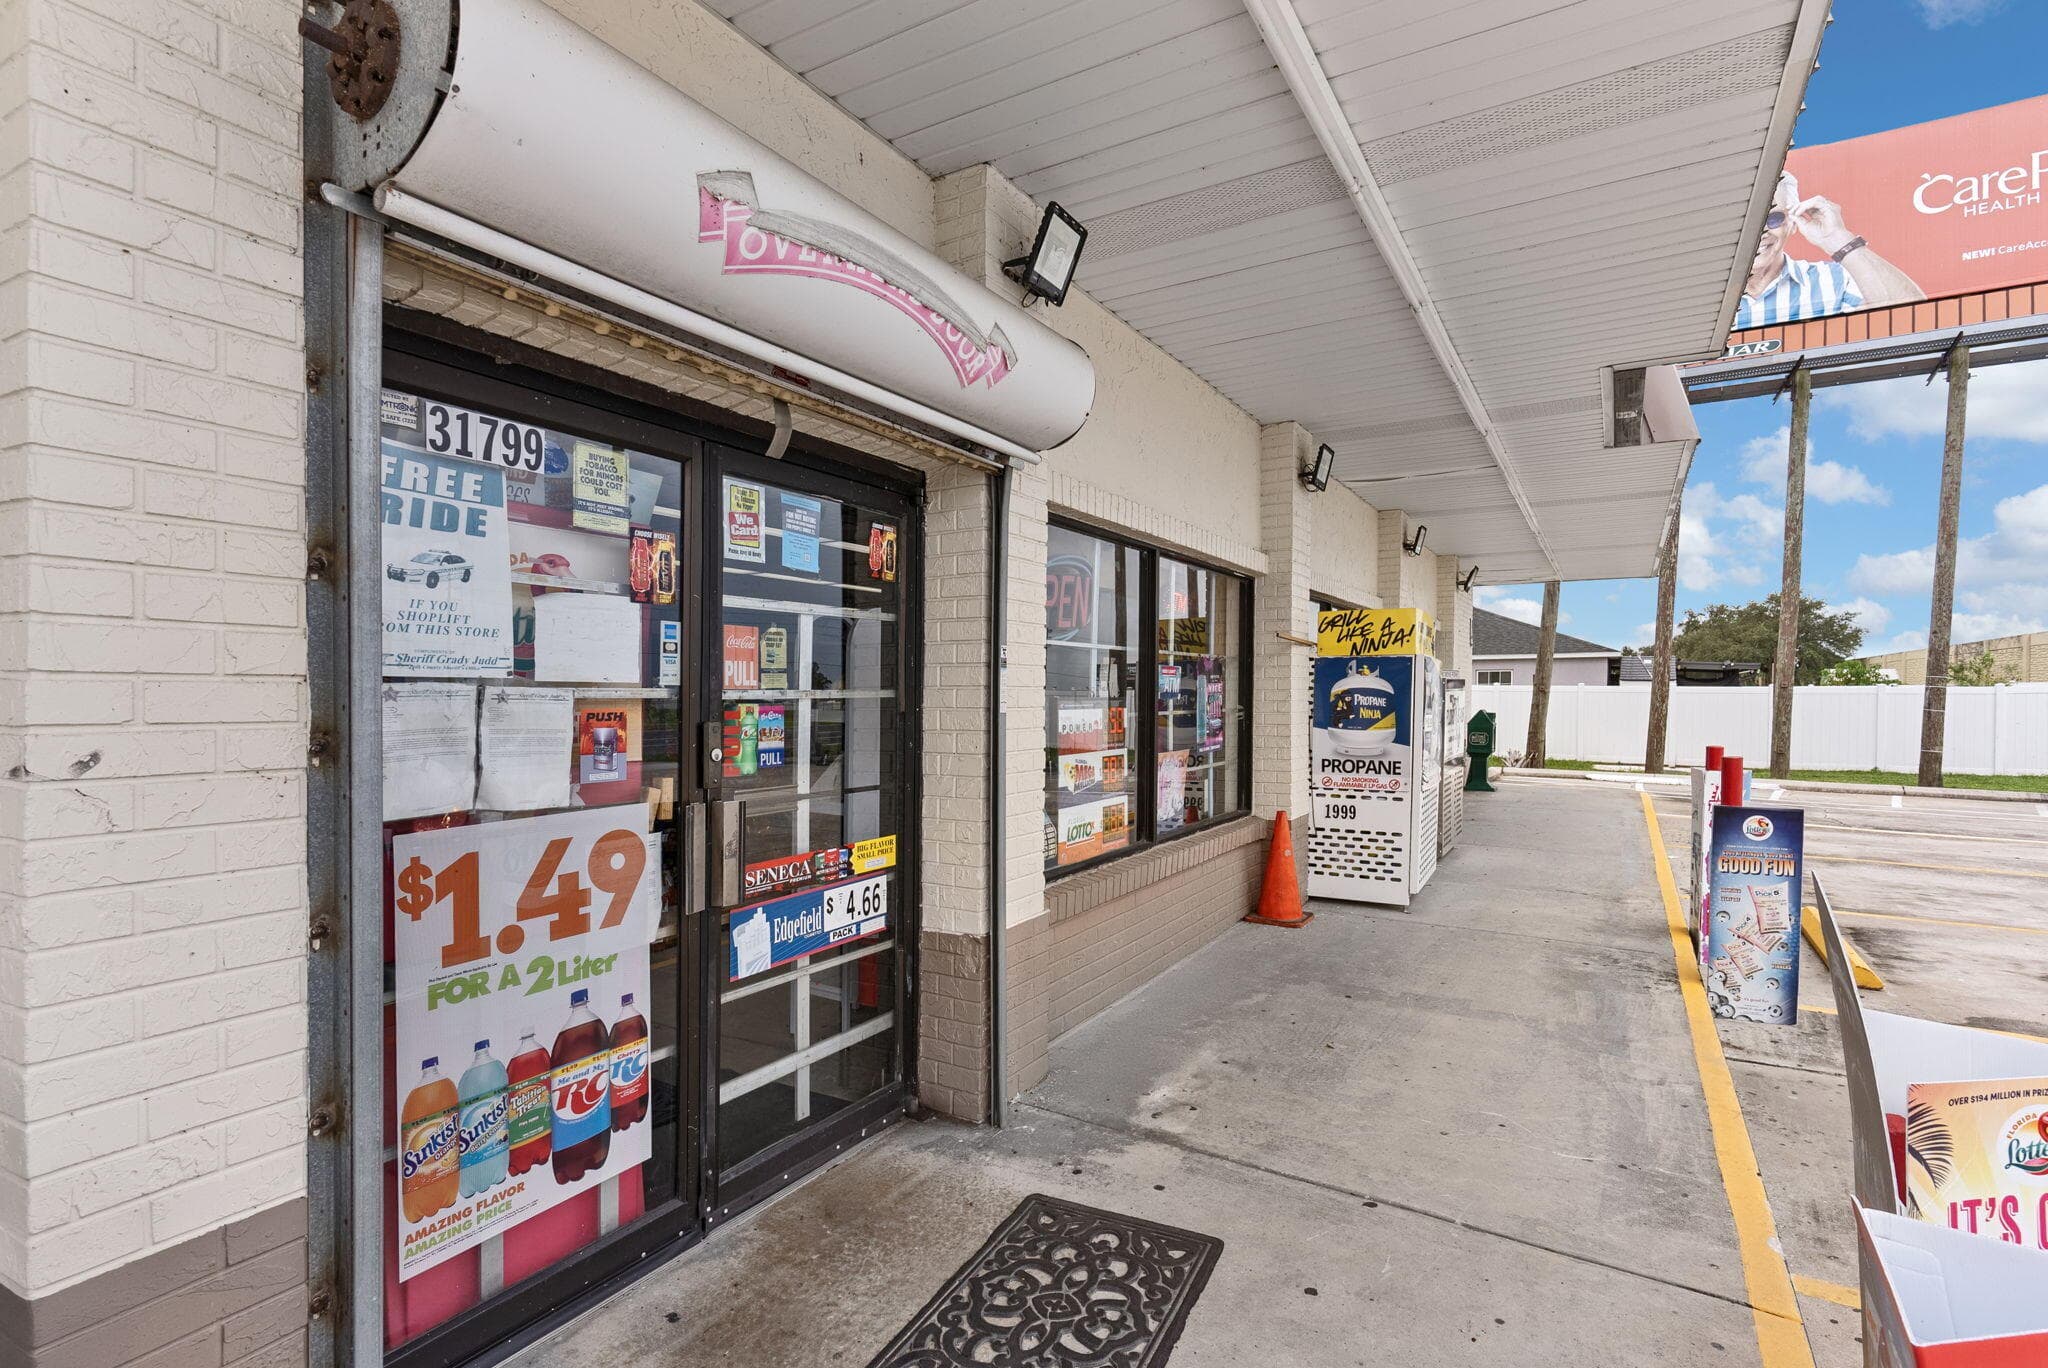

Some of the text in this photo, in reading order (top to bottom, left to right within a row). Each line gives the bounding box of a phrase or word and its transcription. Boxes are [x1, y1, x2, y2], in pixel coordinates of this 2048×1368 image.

[1964, 192, 2040, 217] HEALTH
[1962, 240, 2048, 260] NEW! CareAcc
[428, 405, 544, 471] 31799
[585, 460, 618, 474] TOBACCO
[589, 453, 615, 465] BUYING
[382, 455, 484, 503] FREE
[580, 467, 623, 483] FOR MINORS
[580, 476, 623, 491] COULD COST
[594, 487, 610, 497] YOU.
[382, 492, 488, 538] RIDE
[734, 514, 754, 525] We
[730, 524, 758, 536] Card
[409, 599, 458, 612] IF YOU
[396, 610, 471, 624] SHOPLIFT
[1318, 610, 1370, 634] GRILL
[416, 624, 450, 636] THIS
[455, 626, 500, 638] STORE
[1337, 617, 1396, 643] LIKE A
[1350, 624, 1415, 656] NINJA!
[396, 653, 499, 666] Sheriff Grady Judd
[724, 661, 757, 687] PULL
[1354, 694, 1387, 707] PROPANE
[586, 711, 624, 722] PUSH
[1360, 707, 1382, 719] NINJA
[760, 752, 782, 766] PULL
[1321, 758, 1401, 776] PROPANE
[1325, 804, 1356, 819] 1999
[1067, 822, 1093, 842] LOTTO
[857, 839, 895, 853] BIG FLAVOR
[857, 847, 893, 861] SMALL PRICE
[745, 860, 811, 888] SENECA
[1719, 857, 1795, 877] GOOD FUN
[396, 829, 647, 969] $1.49
[774, 883, 880, 944] Edgefield $ 4.66
[832, 926, 854, 940] PACK
[428, 952, 618, 1011] FOR A 2 Liter
[617, 1048, 640, 1060] Cherry
[558, 1063, 605, 1086] Me and My
[610, 1051, 648, 1083] RC
[510, 1085, 547, 1108] Tahitian
[552, 1070, 609, 1115] RC
[1948, 1096, 1969, 1107] OVER
[1970, 1095, 1988, 1103] $194
[1990, 1090, 2021, 1101] MILLION
[516, 1095, 543, 1117] Treat
[459, 1093, 508, 1154] Sunkist
[2006, 1112, 2038, 1139] FLORIDA
[403, 1113, 459, 1178] Sunkist
[404, 1206, 473, 1247] AMAZING
[476, 1181, 526, 1212] FLAVOR
[1947, 1195, 2022, 1245] IT'S
[404, 1220, 473, 1260] AMAZING
[477, 1200, 513, 1226] PRICE
